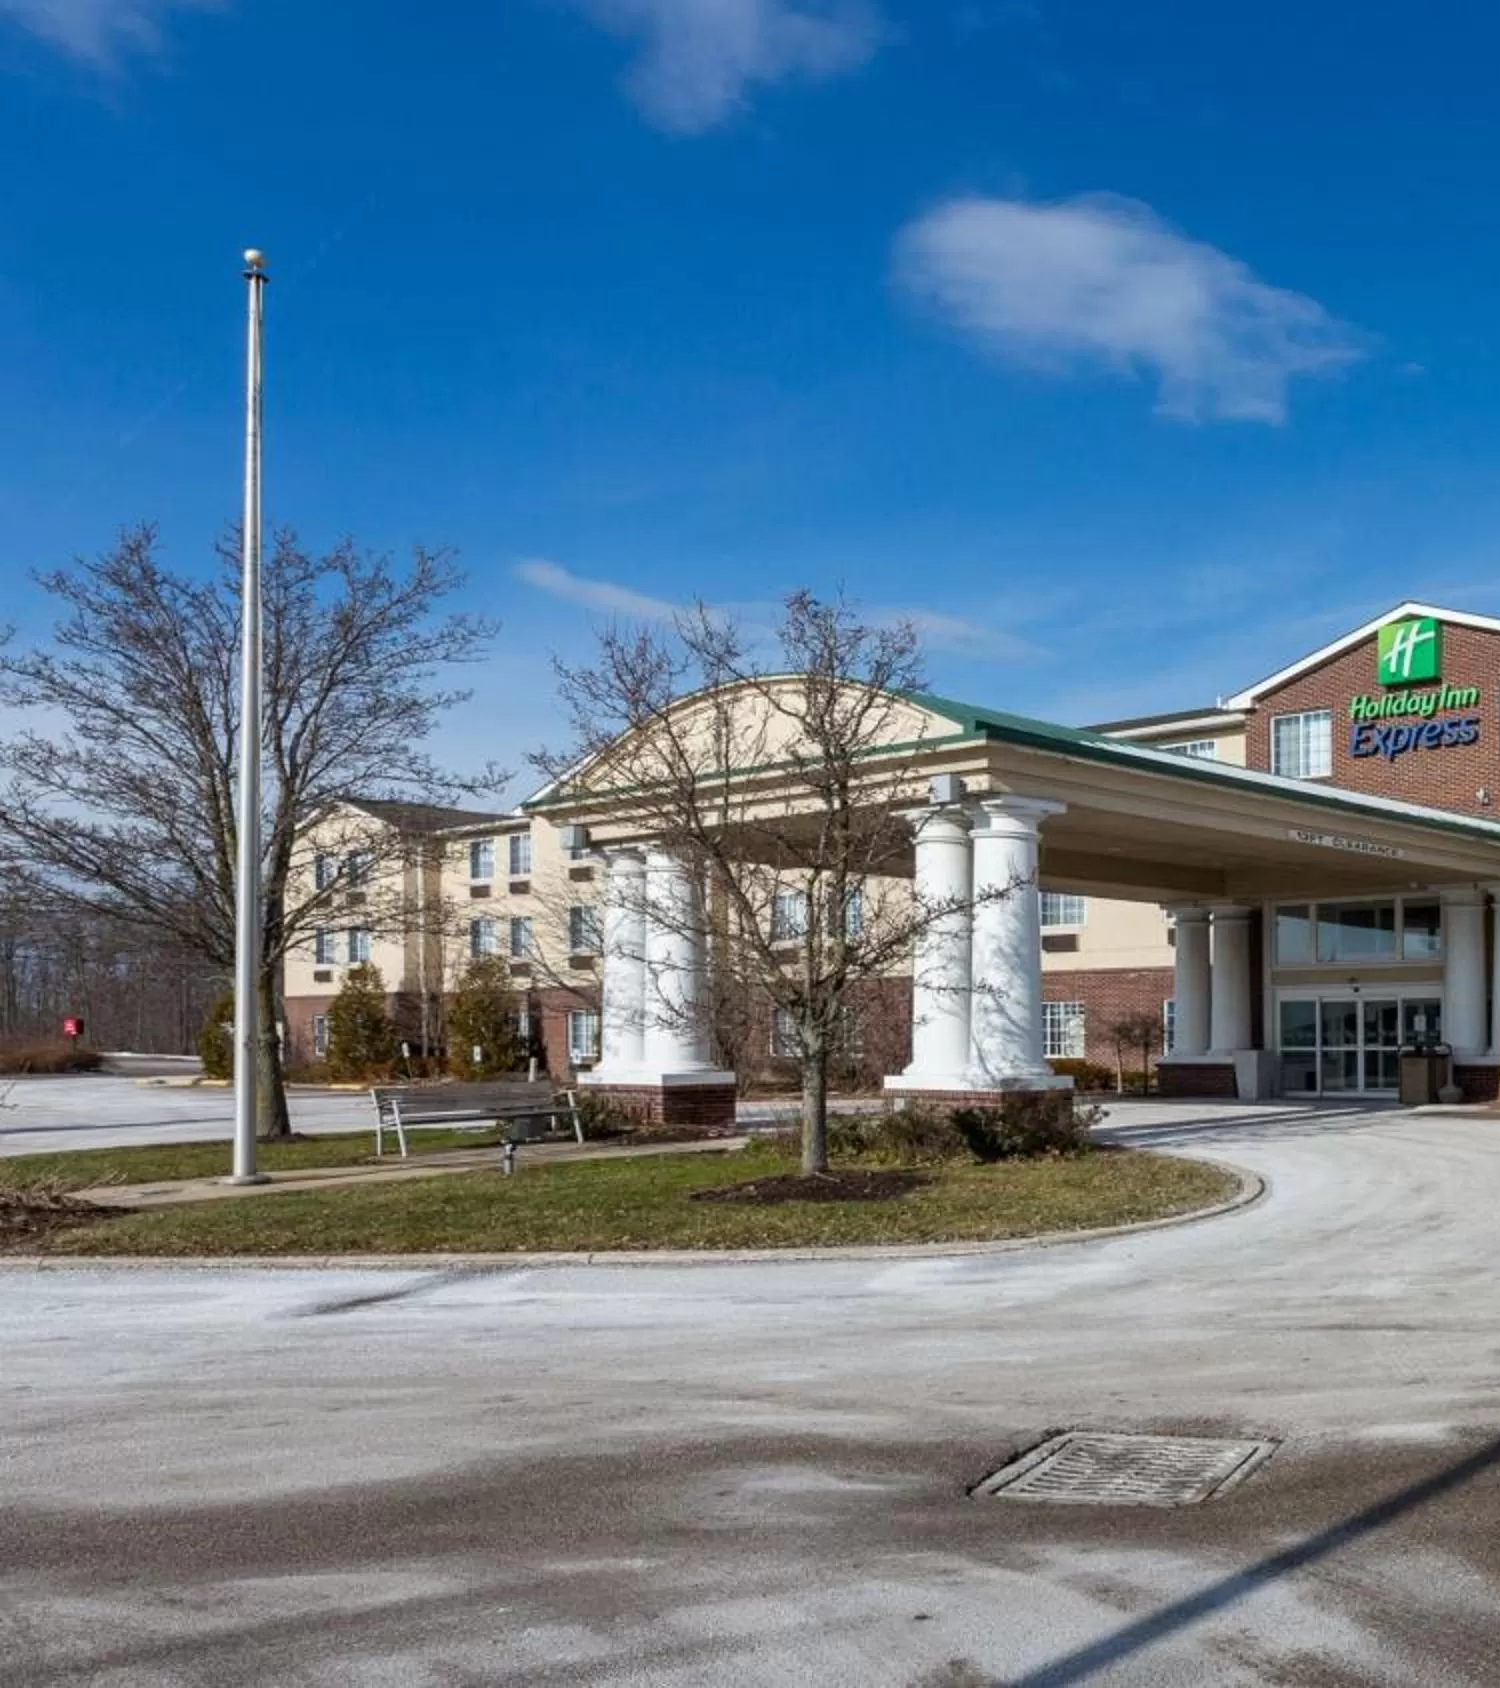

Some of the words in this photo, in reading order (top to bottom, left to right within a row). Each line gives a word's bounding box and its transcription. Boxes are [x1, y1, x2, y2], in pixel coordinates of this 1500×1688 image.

[1349, 689, 1436, 719] Holiday
[1438, 684, 1480, 711] Inn
[1350, 717, 1480, 762] Express
